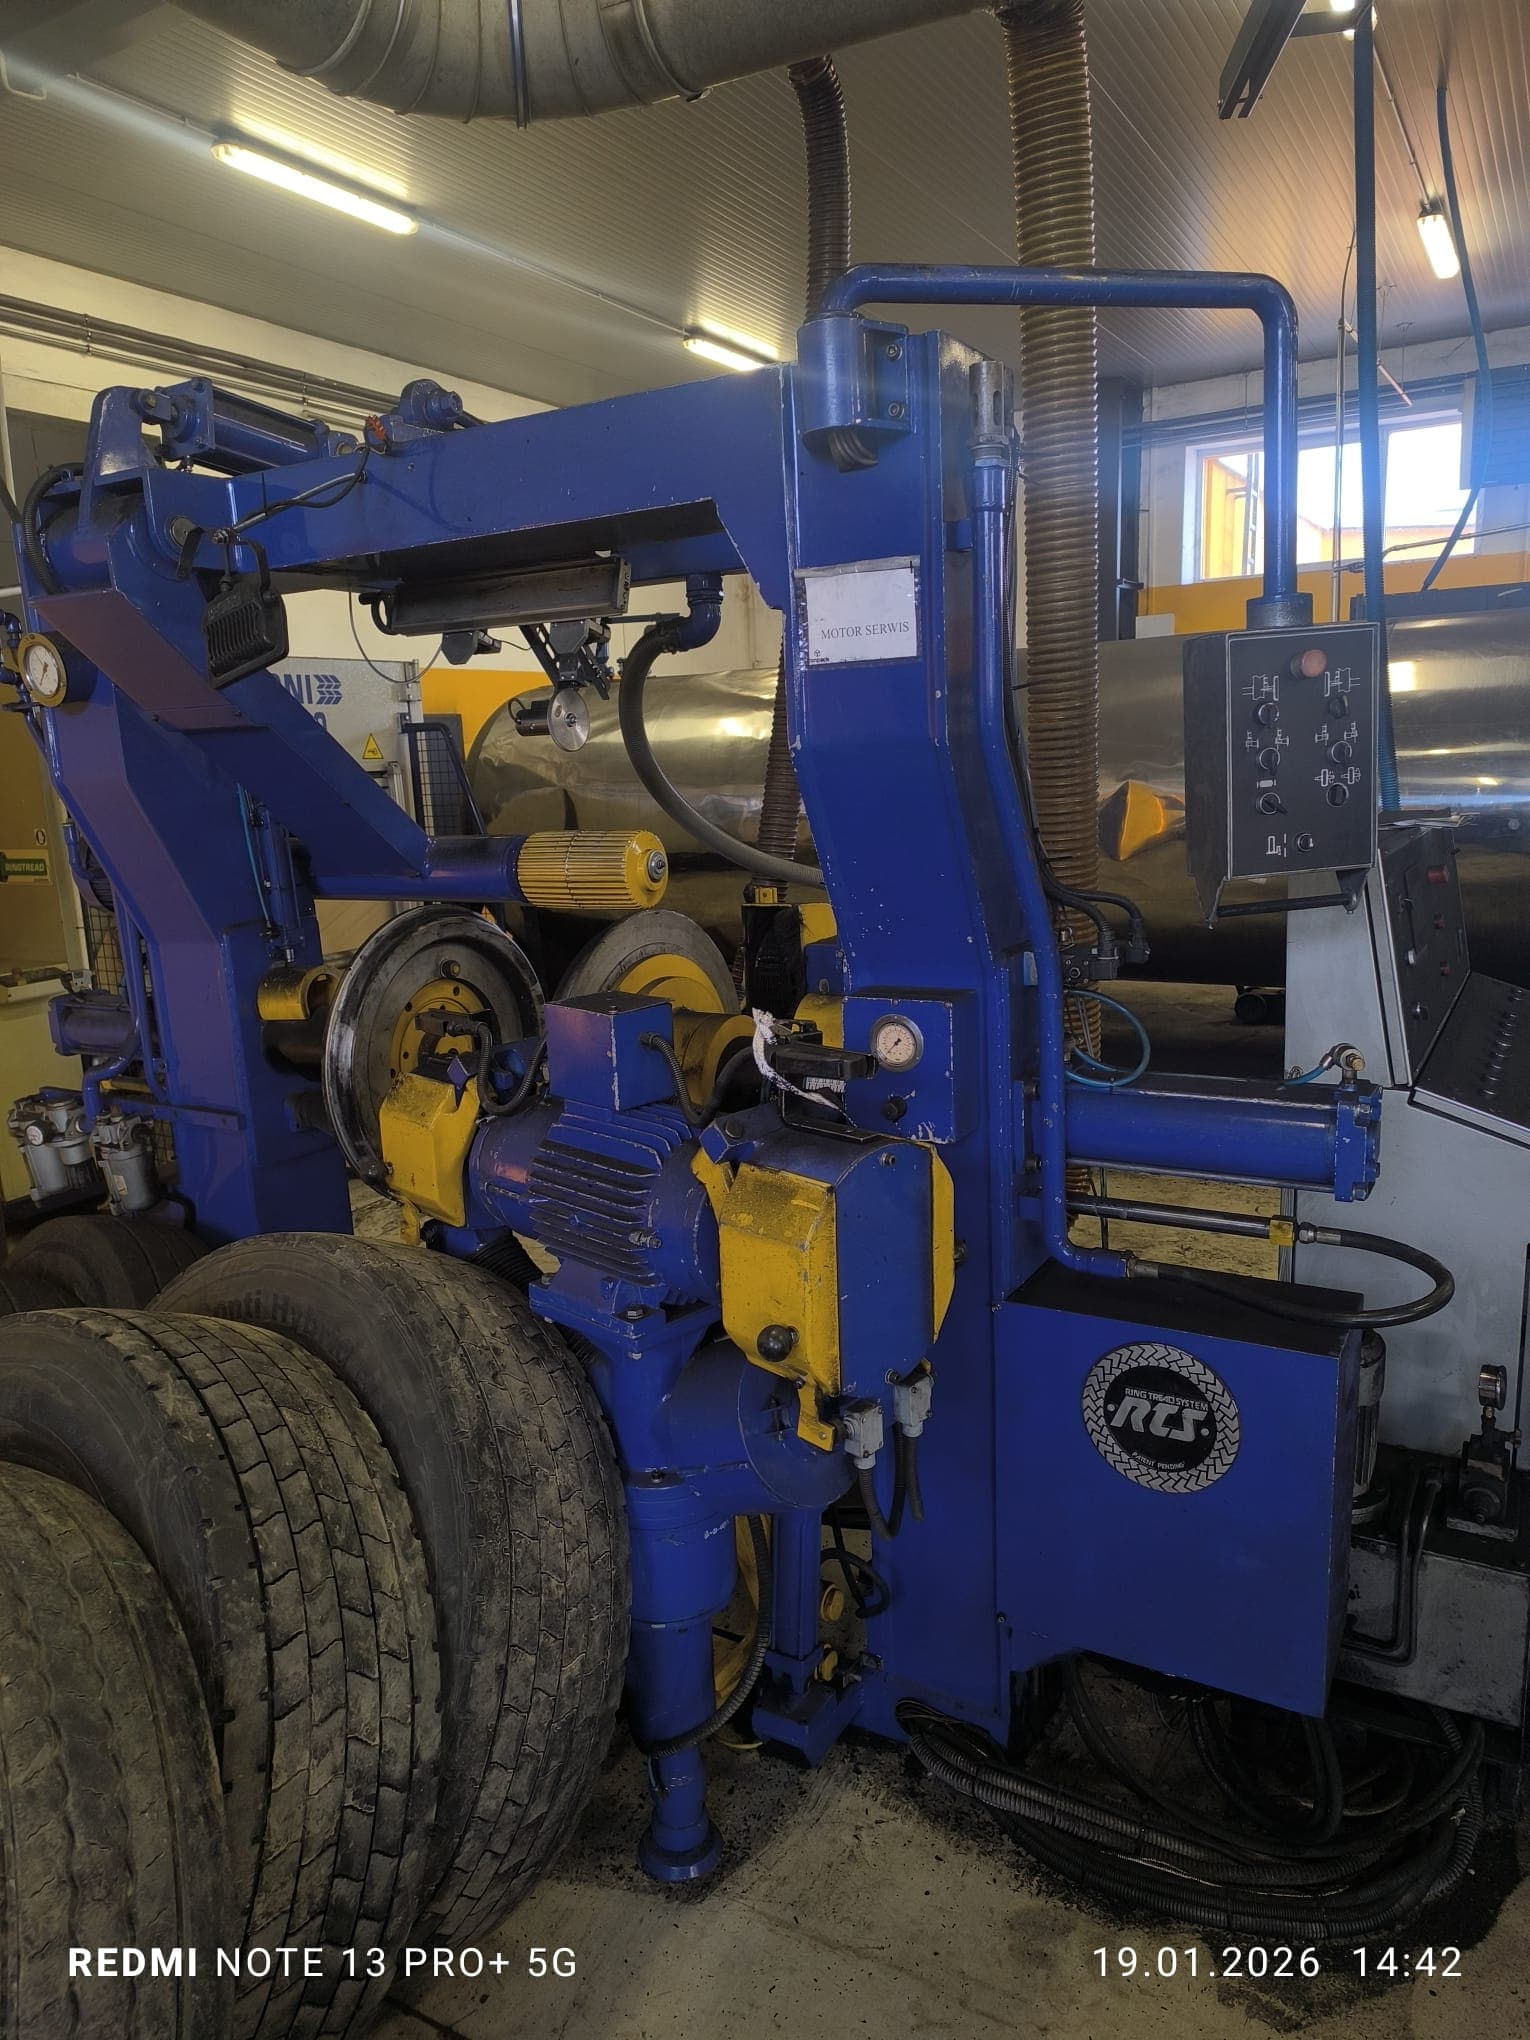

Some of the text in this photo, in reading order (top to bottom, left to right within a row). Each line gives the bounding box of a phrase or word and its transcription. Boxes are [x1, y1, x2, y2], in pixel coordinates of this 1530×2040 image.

[821, 621, 910, 640] MOTOR SERWIS
[1125, 1388, 1209, 1411] RING TREAD SYSTEM
